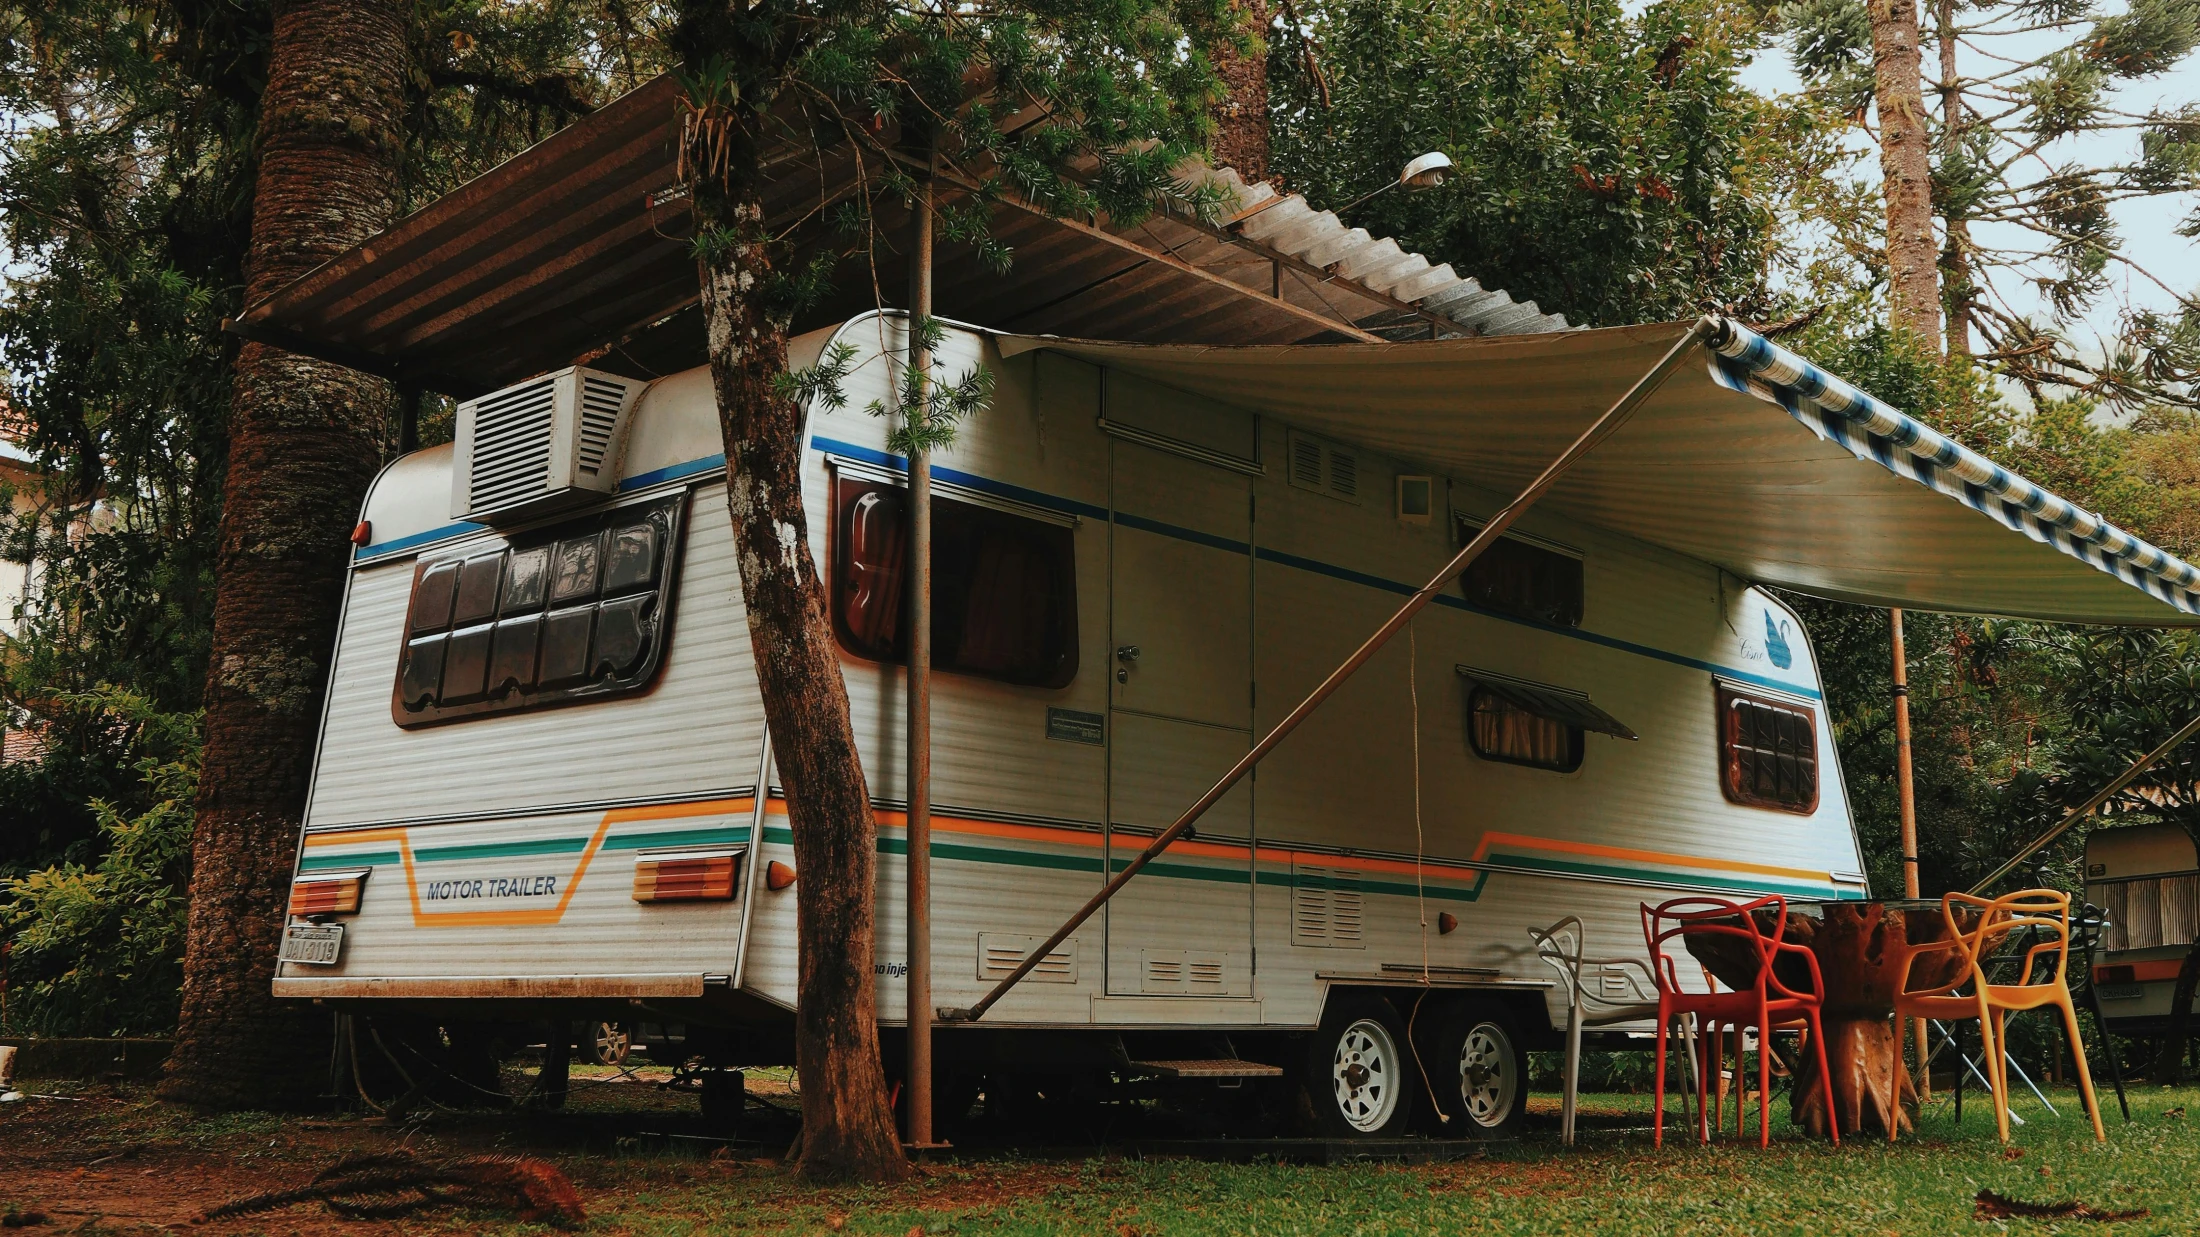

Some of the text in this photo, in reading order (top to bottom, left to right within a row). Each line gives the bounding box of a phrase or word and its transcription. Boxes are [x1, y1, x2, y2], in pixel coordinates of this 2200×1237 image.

[427, 876, 556, 900] MOTOR TRAILER
[887, 962, 908, 978] inje
